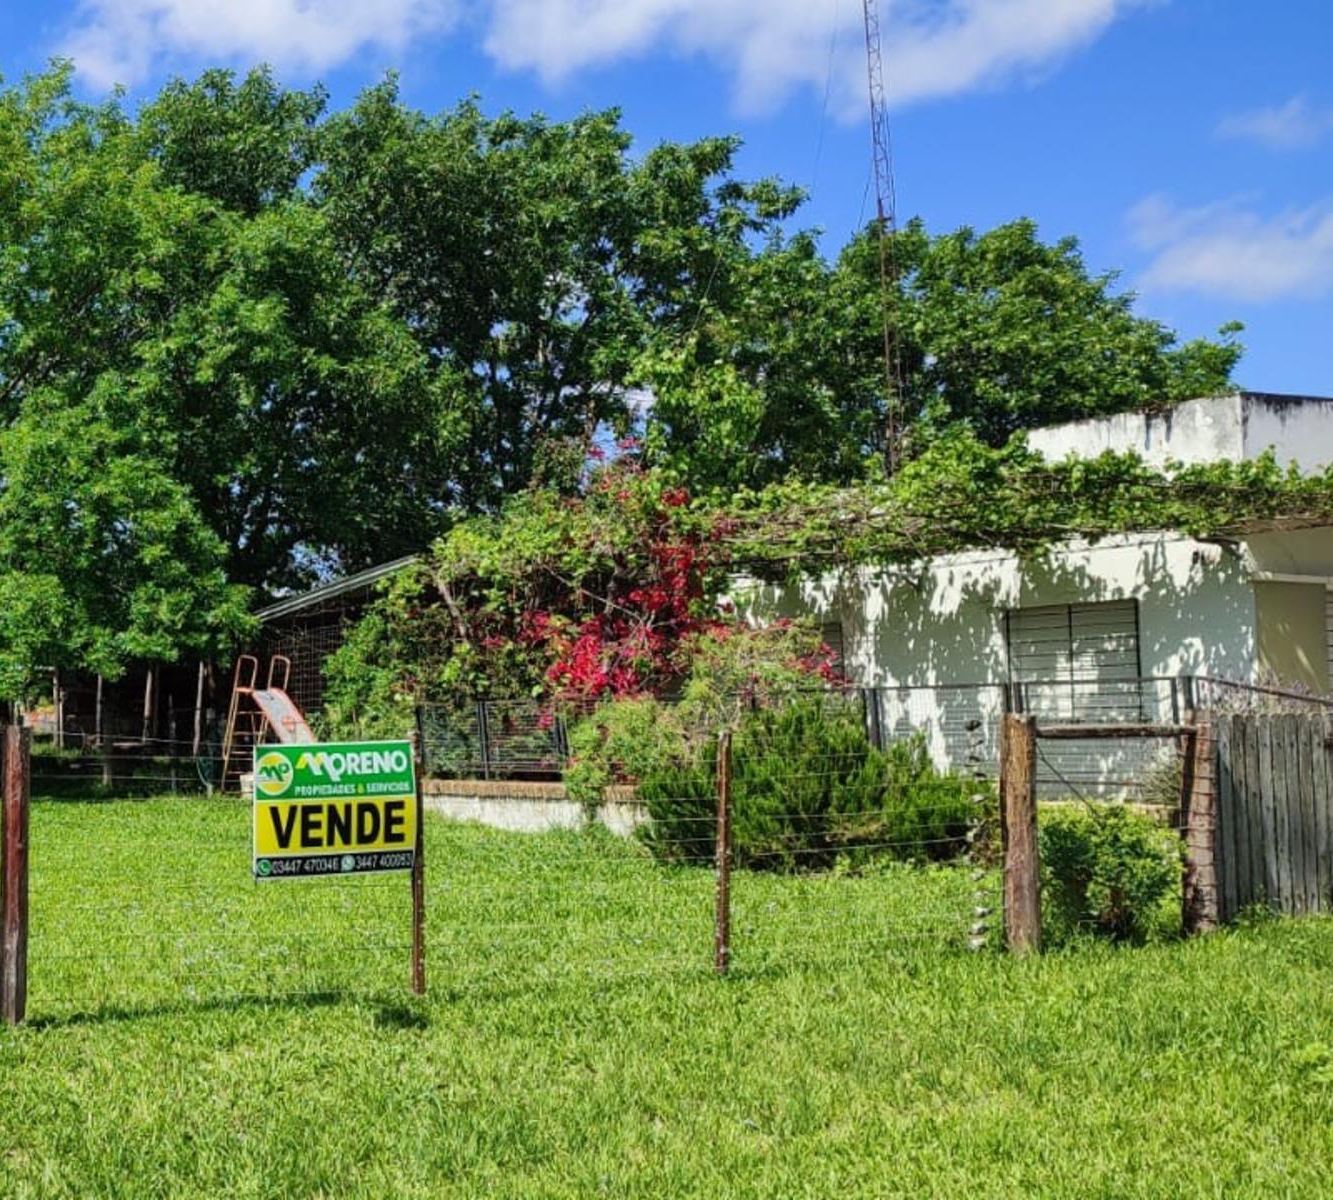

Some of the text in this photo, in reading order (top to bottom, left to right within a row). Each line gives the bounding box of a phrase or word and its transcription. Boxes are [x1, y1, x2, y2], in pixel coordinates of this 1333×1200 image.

[295, 750, 408, 782] MORENO
[295, 784, 356, 796] PROPIEDADES
[366, 781, 411, 793] SERVICIOS
[269, 800, 405, 849] VENDE
